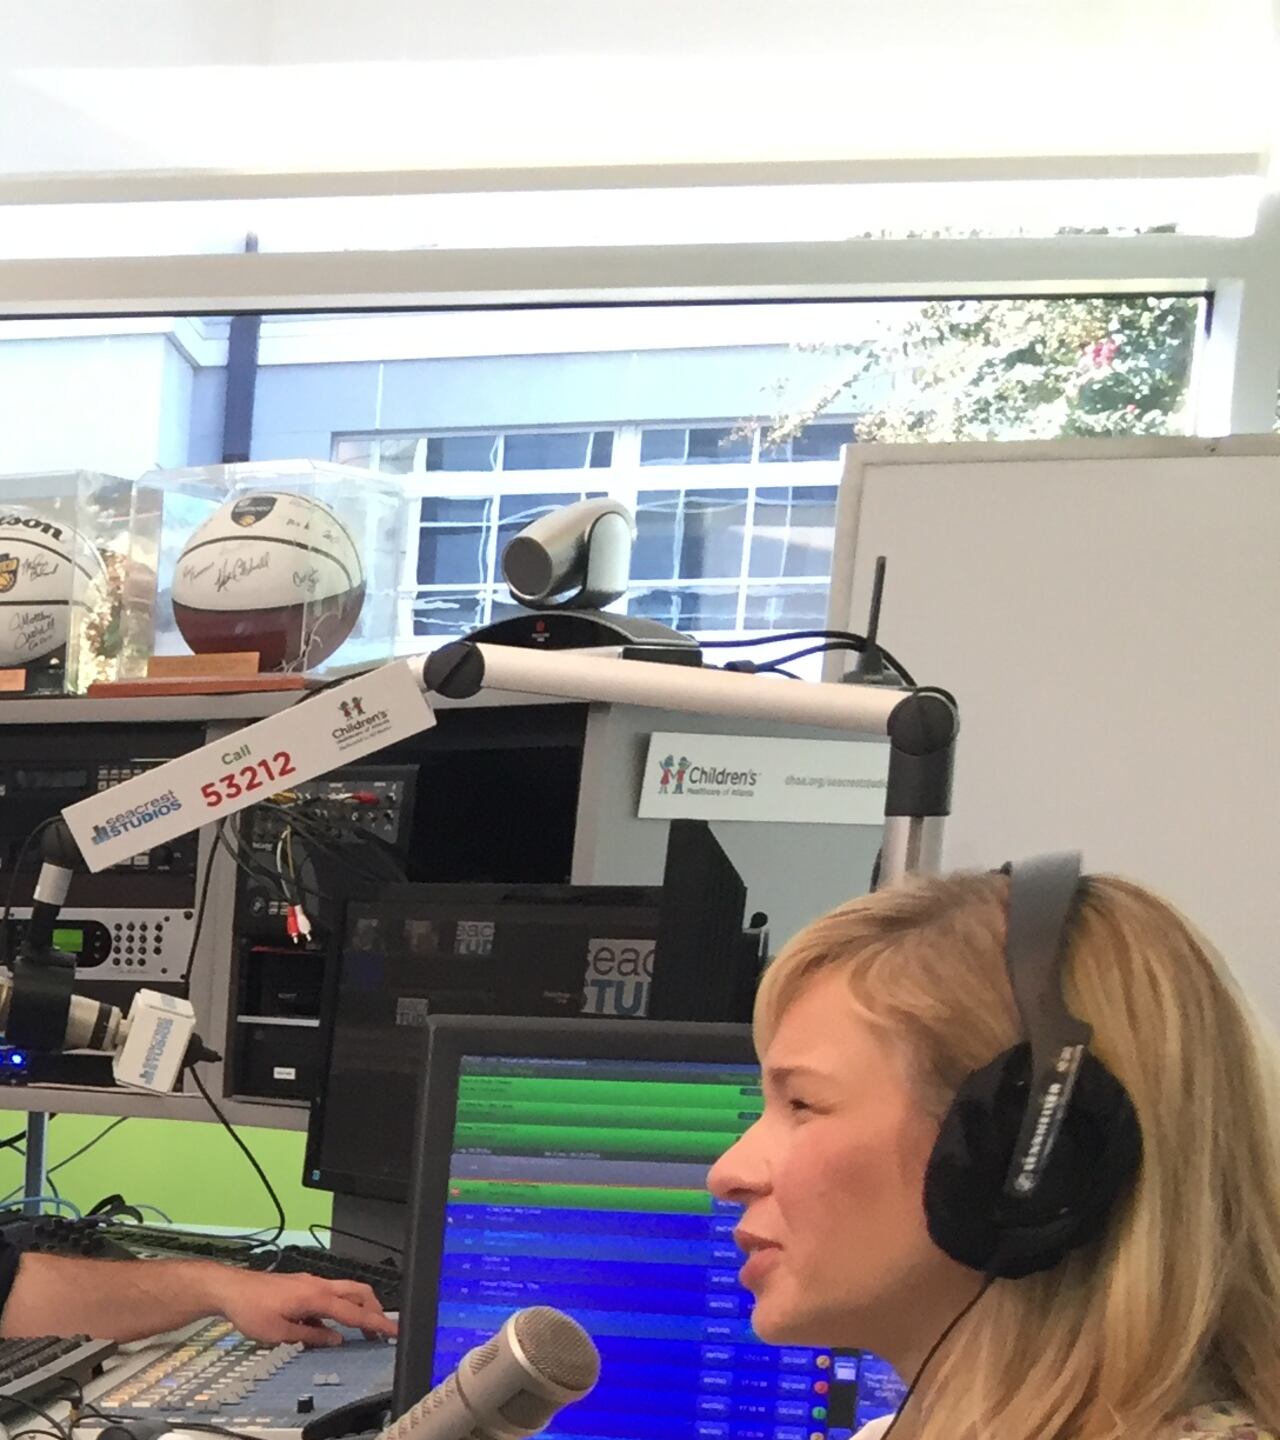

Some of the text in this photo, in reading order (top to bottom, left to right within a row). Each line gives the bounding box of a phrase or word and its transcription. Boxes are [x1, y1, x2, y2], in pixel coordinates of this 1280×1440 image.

[220, 743, 252, 766] Call
[199, 750, 297, 809] 53212
[689, 765, 758, 787] Children's
[105, 788, 176, 828] seacrest
[109, 799, 183, 839] STUDIOS
